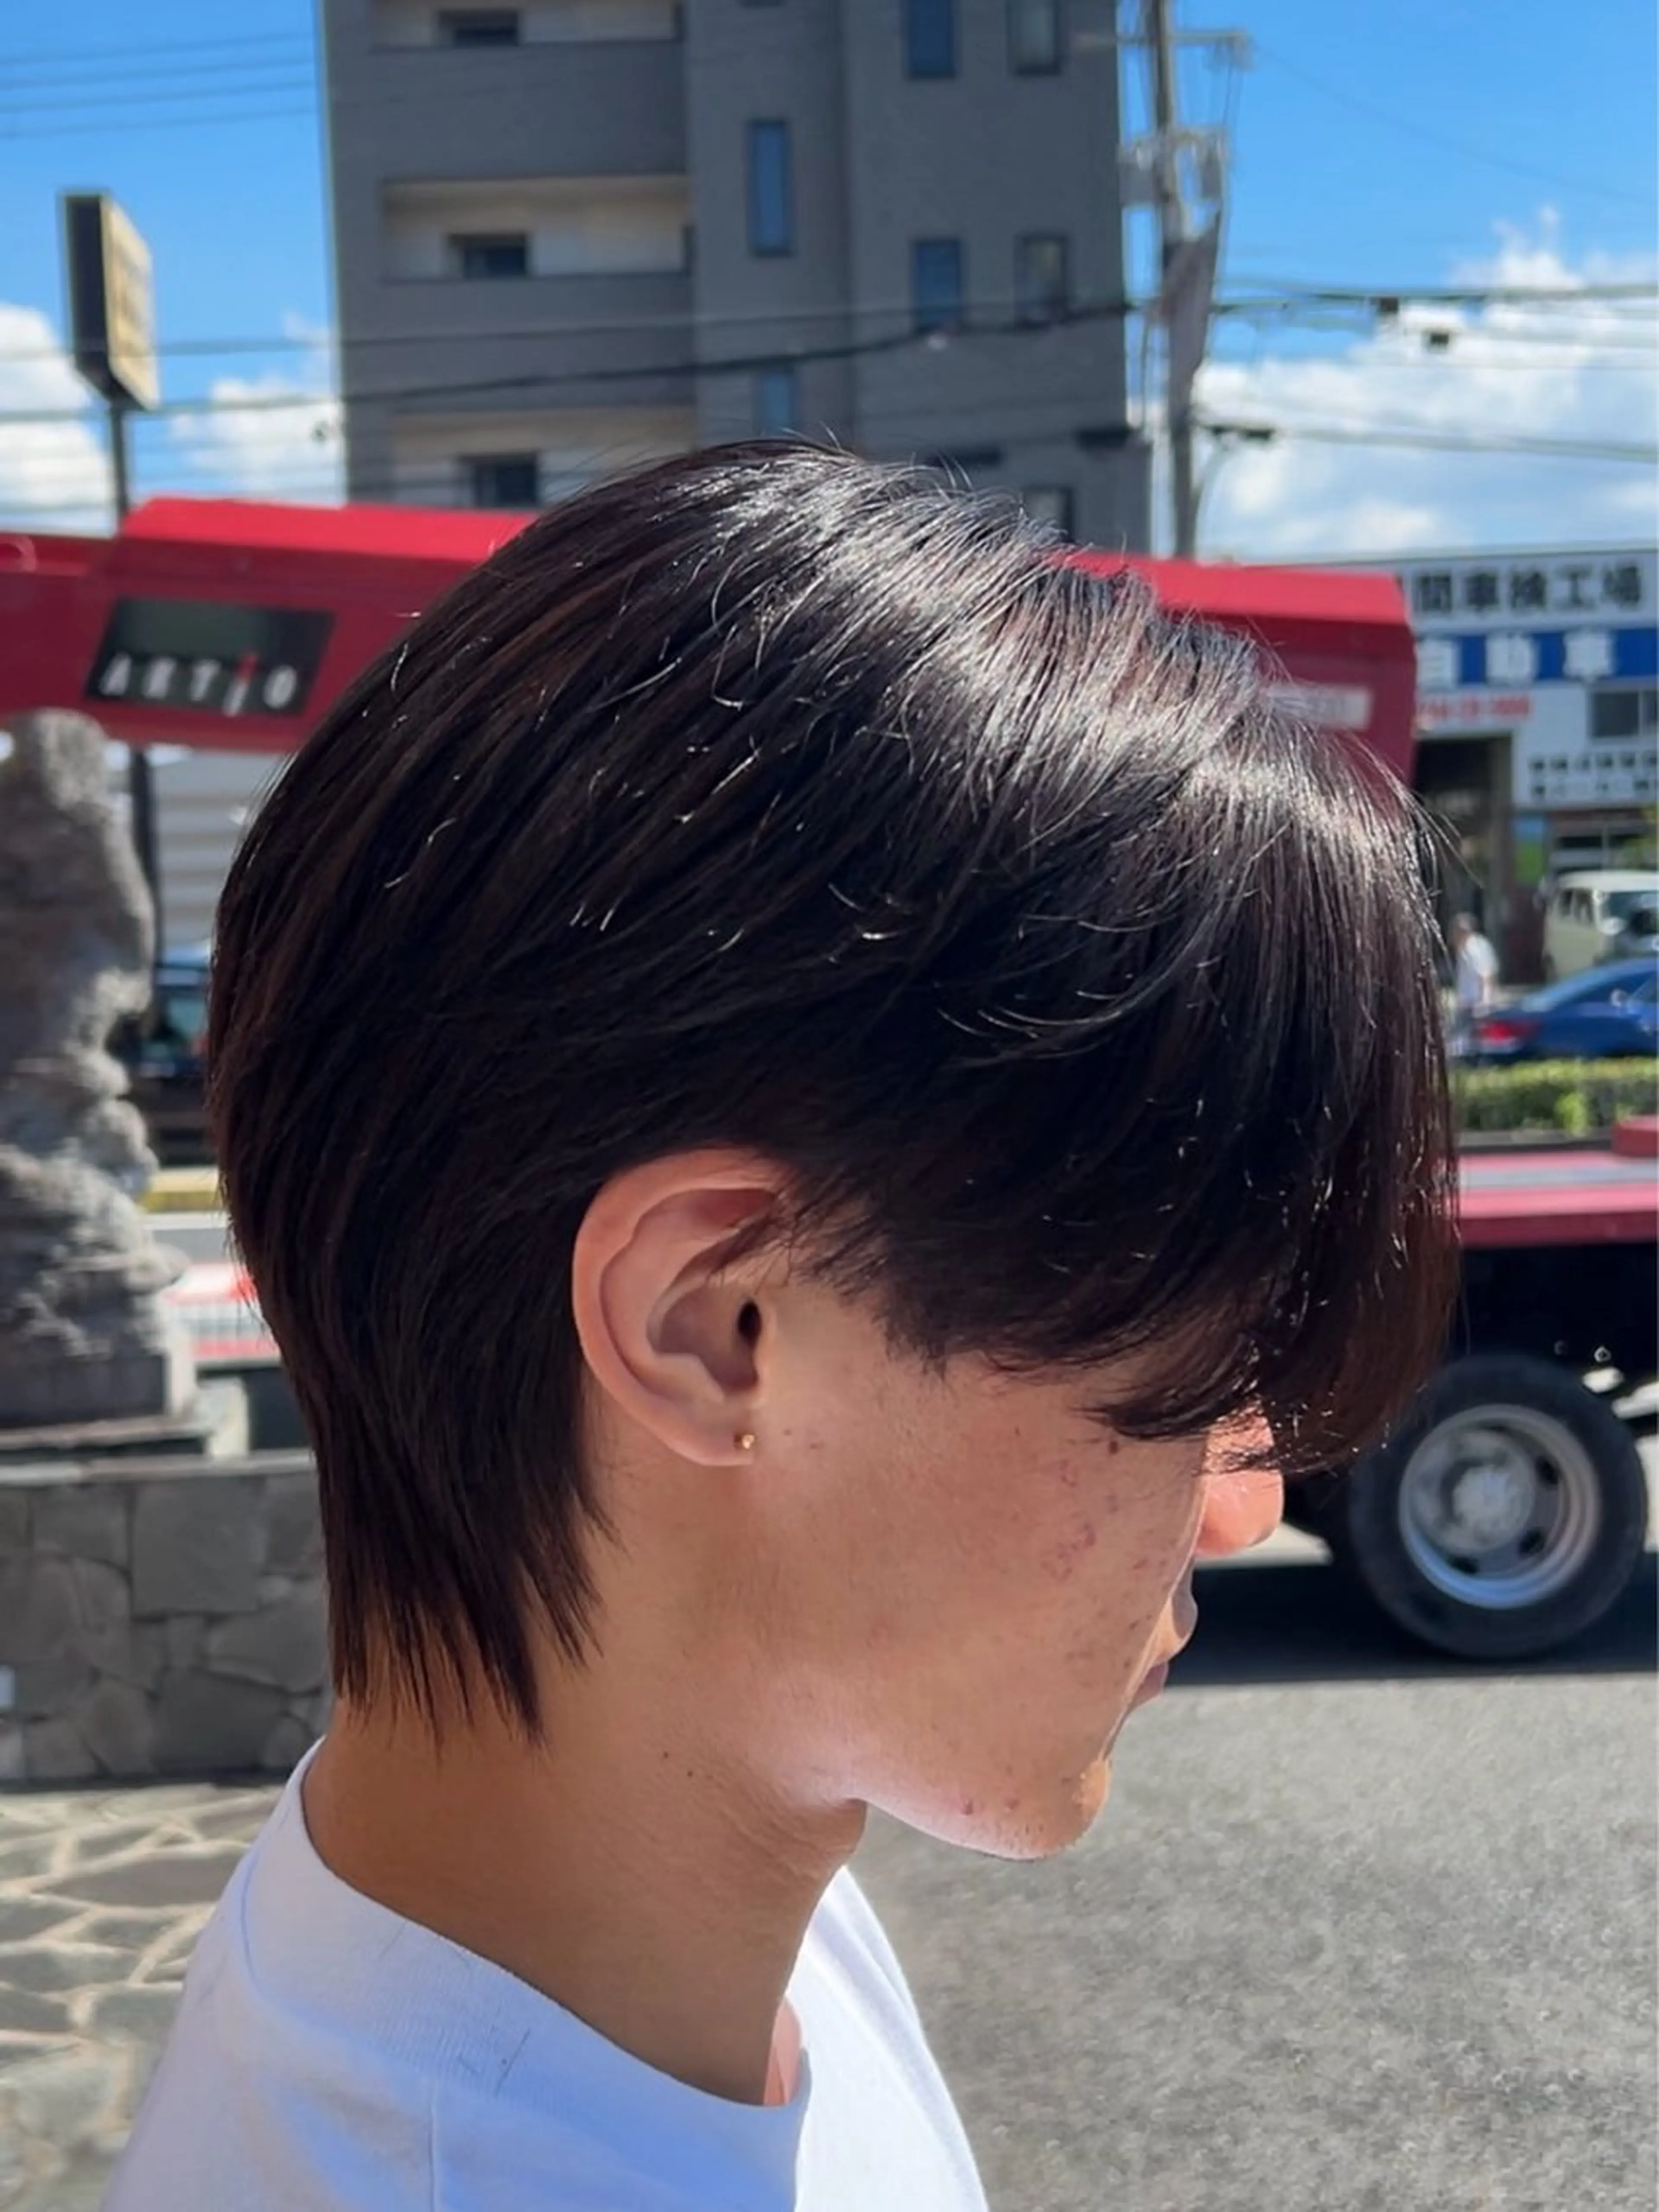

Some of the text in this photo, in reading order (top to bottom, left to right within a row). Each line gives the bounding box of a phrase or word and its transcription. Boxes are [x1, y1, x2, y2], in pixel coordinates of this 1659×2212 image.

[1397, 564, 1642, 613] 間車検工場
